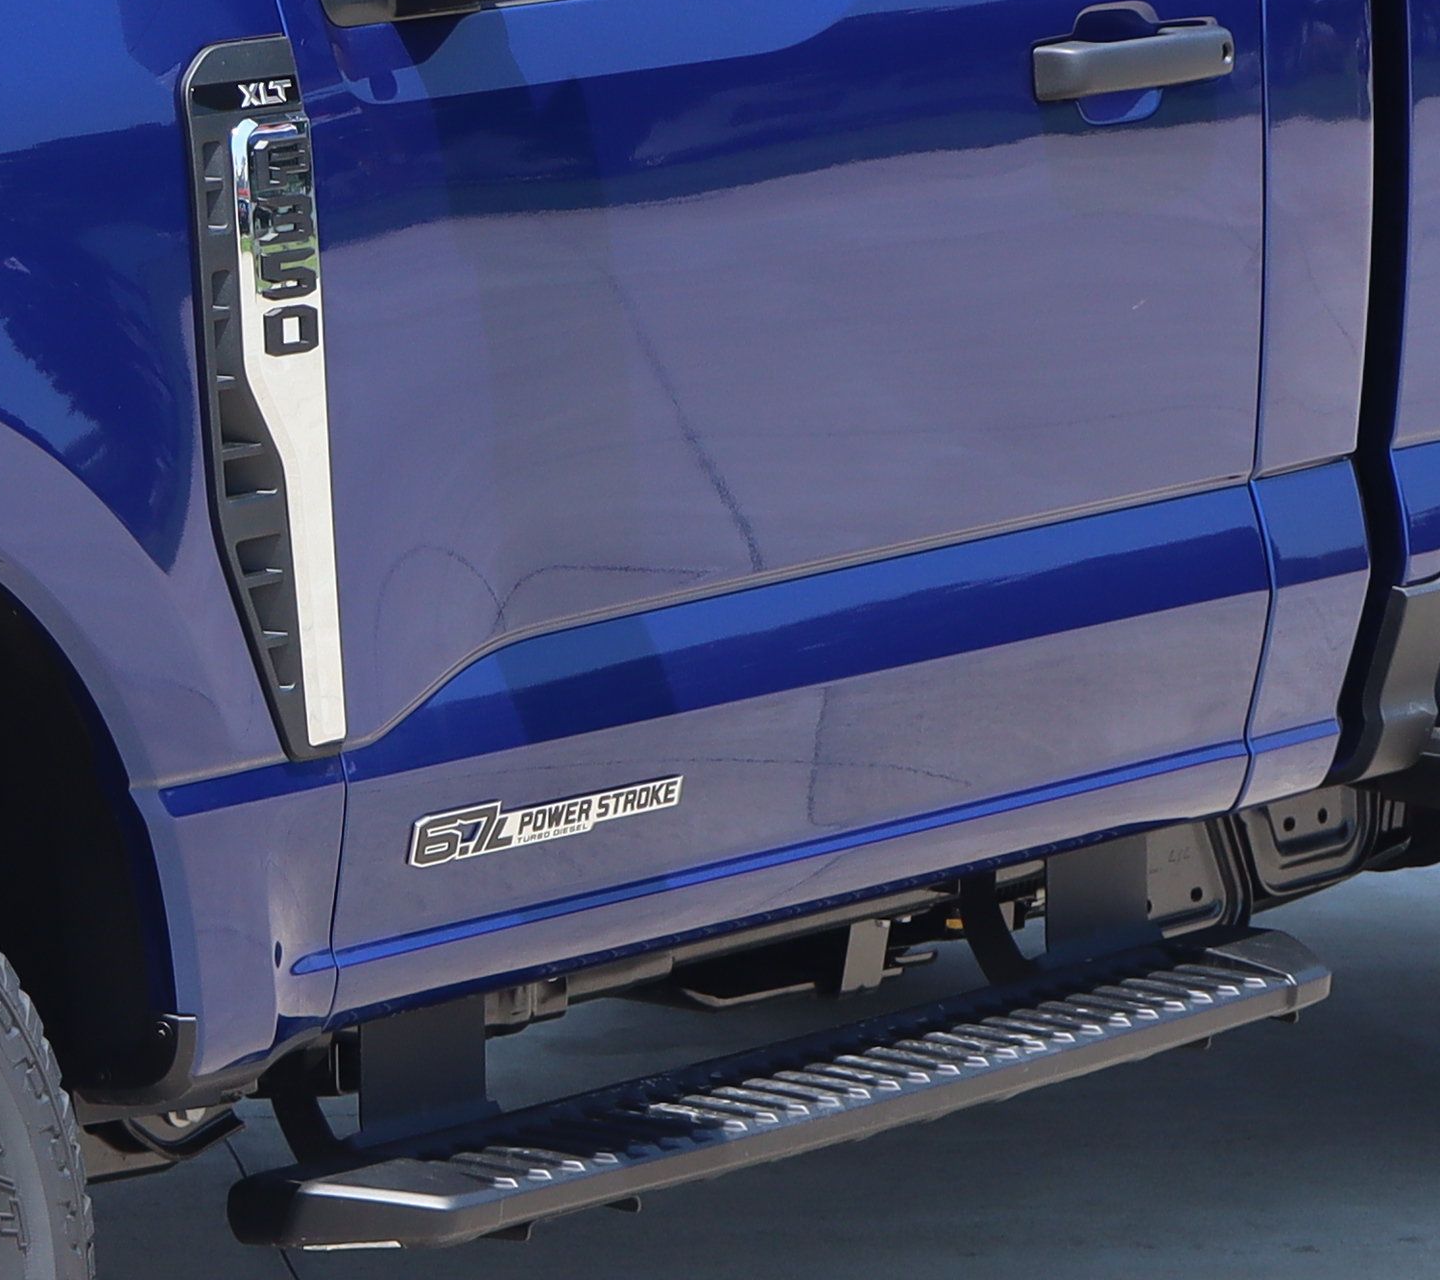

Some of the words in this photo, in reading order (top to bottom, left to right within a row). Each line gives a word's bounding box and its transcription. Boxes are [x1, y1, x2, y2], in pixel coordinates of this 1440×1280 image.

[237, 79, 292, 108] XLT
[411, 801, 515, 867] 6.7L
[517, 798, 593, 836] POWER
[596, 779, 680, 819] STROKE
[517, 829, 550, 844] TURBO
[552, 822, 589, 837] DIESEL
